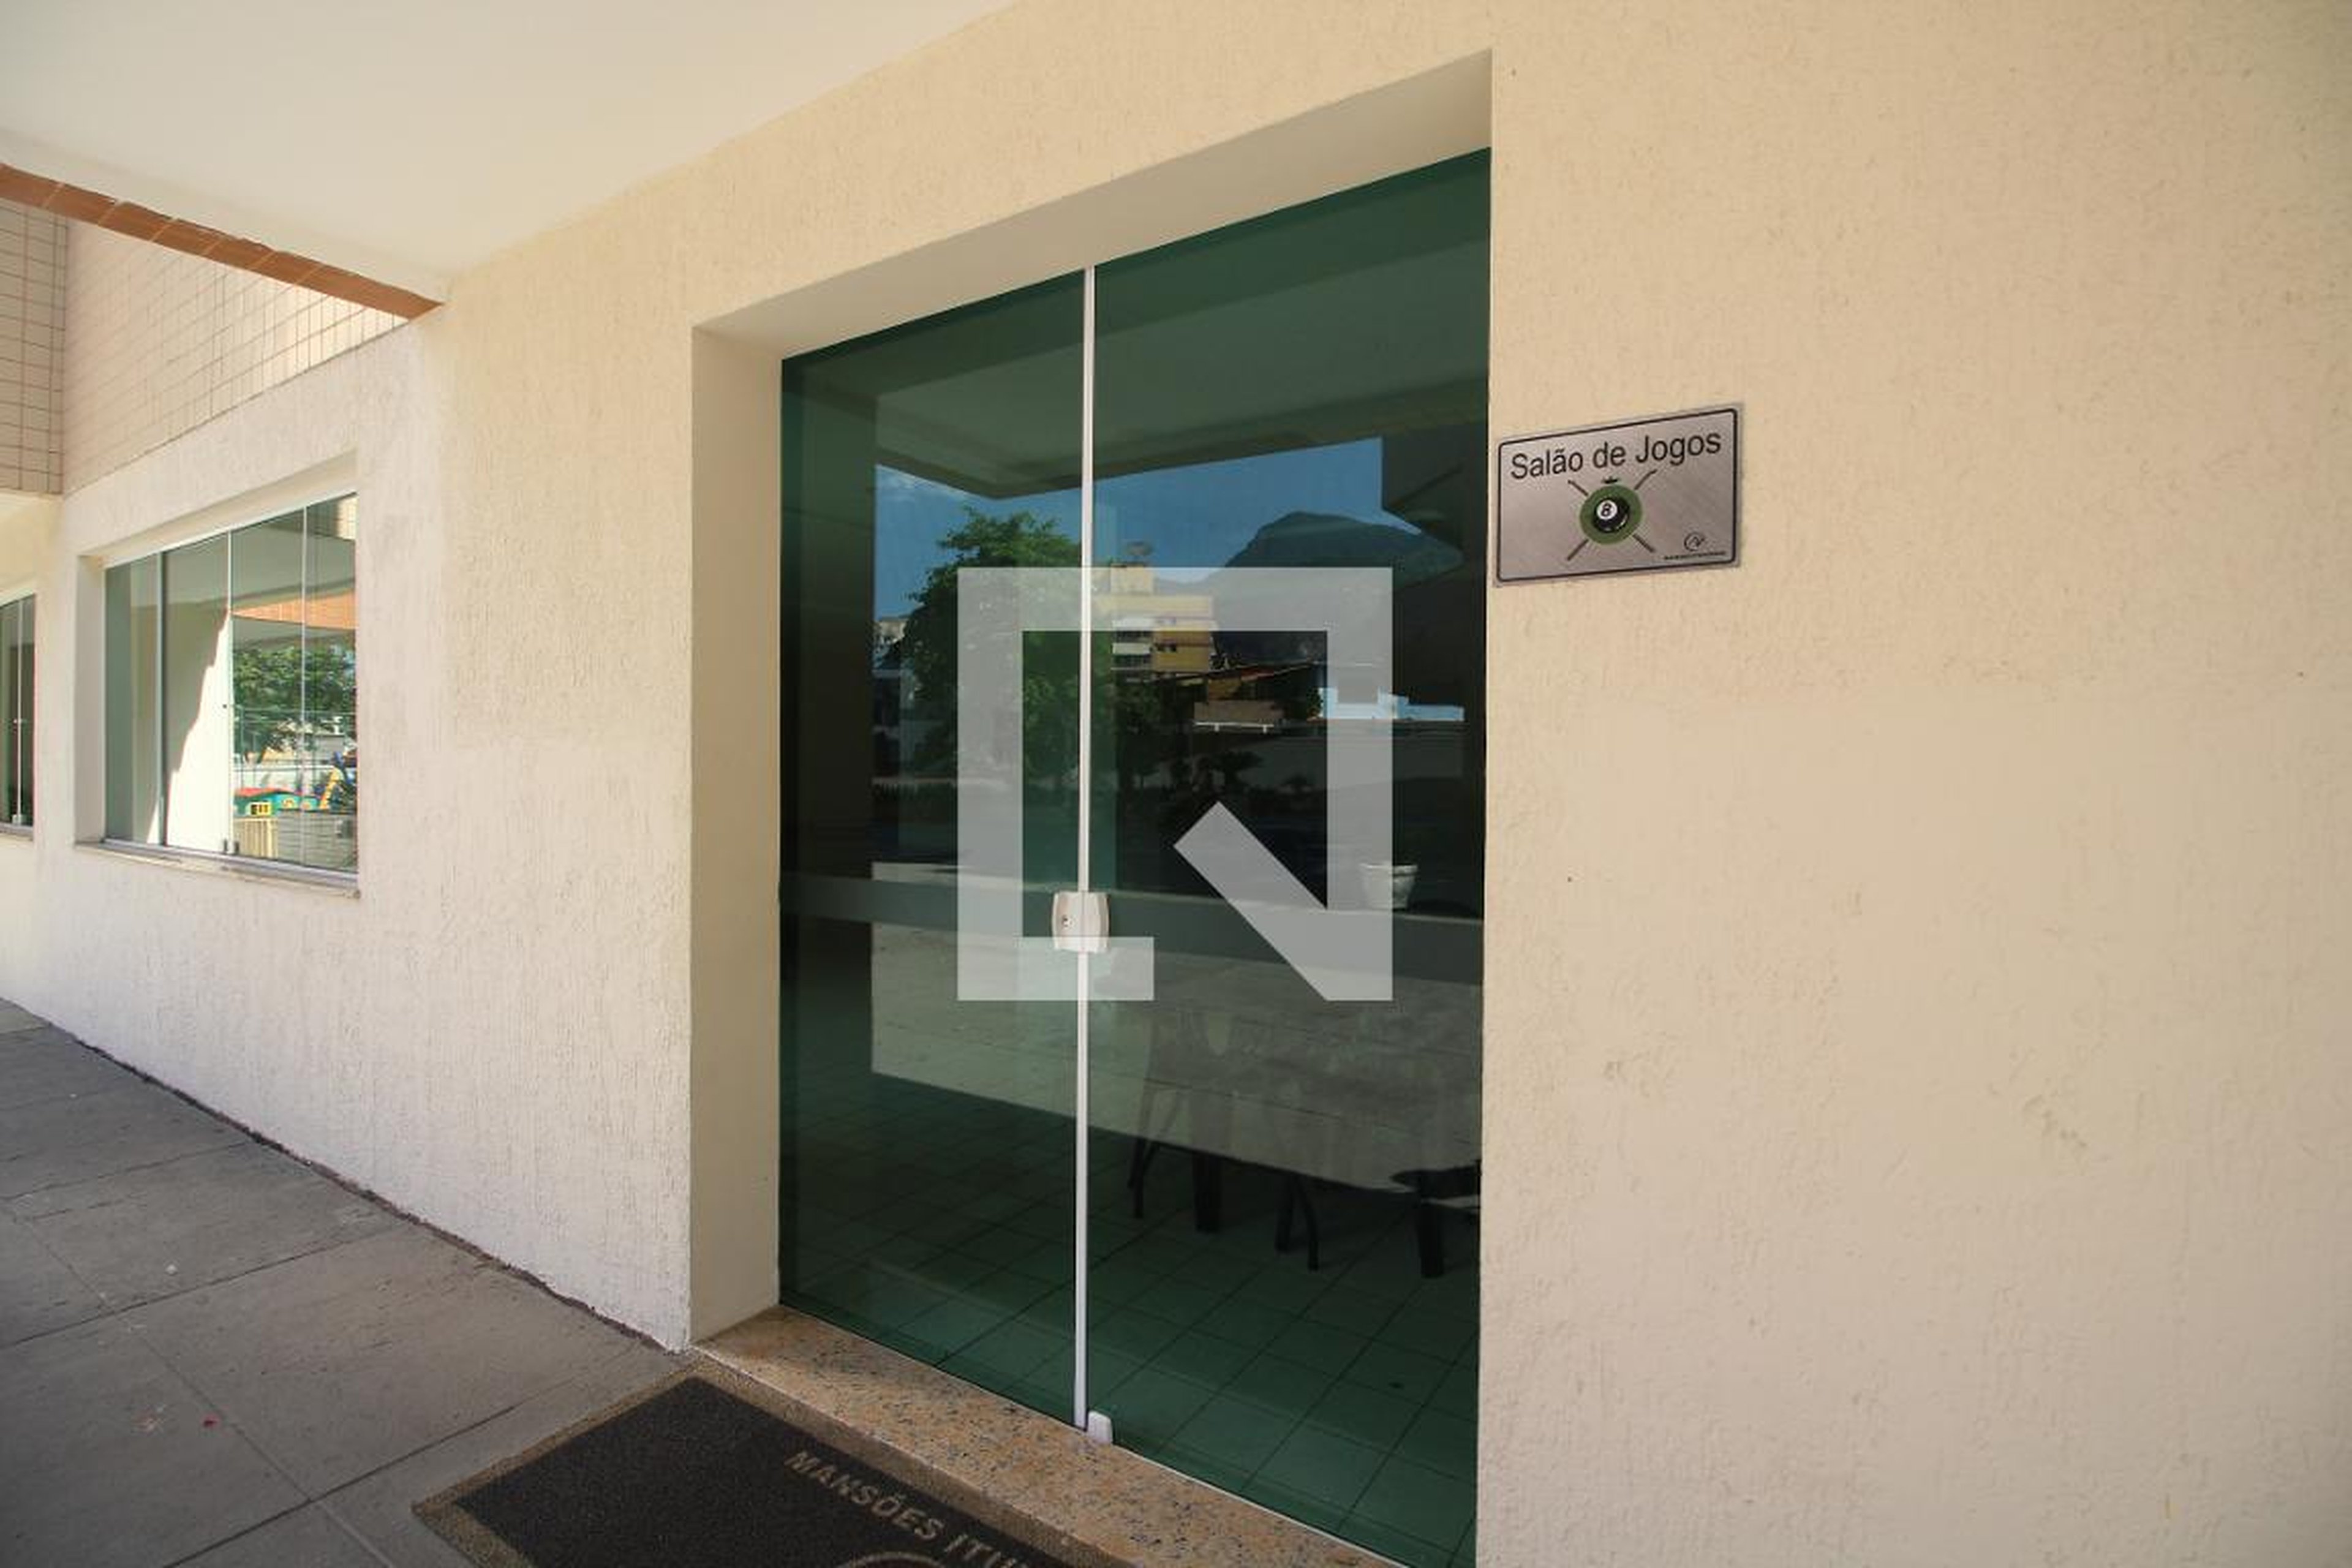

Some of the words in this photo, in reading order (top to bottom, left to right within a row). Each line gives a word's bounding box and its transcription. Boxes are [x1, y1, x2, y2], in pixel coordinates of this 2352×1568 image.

[1510, 448, 1583, 480] Salão
[1593, 441, 1626, 468] de
[1636, 432, 1722, 466] Jogos
[1600, 502, 1613, 517] 8
[783, 1450, 944, 1540] MANSÕES
[944, 1533, 1029, 1568] ITU
